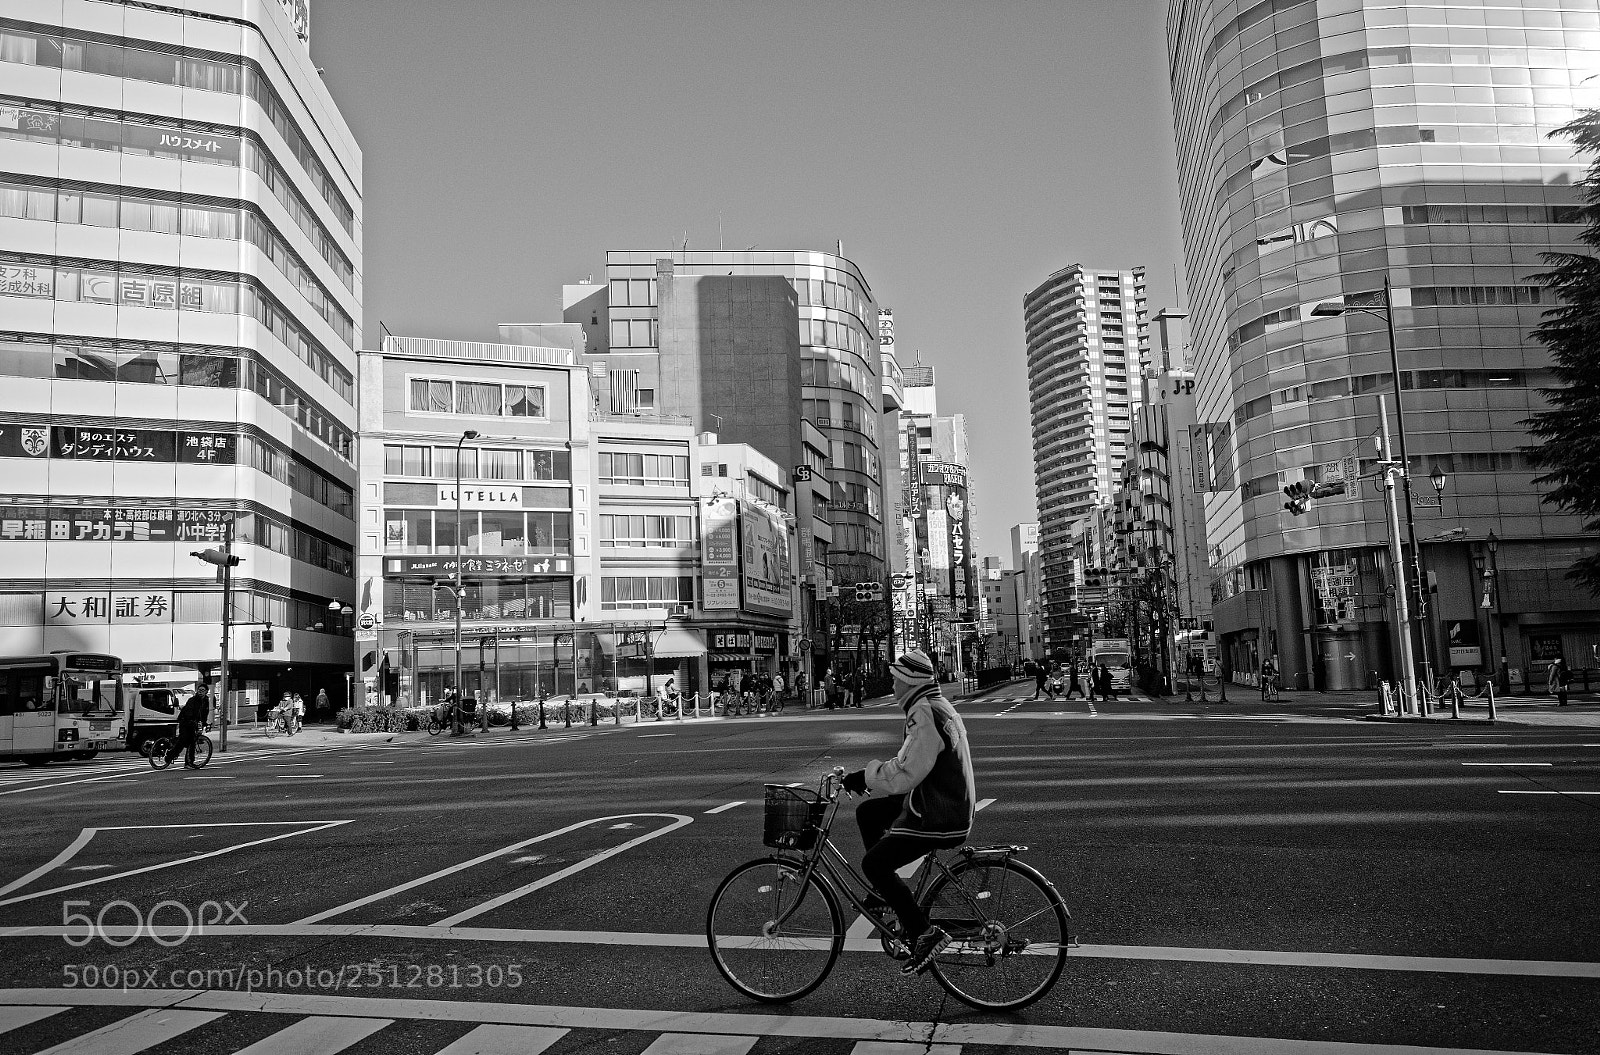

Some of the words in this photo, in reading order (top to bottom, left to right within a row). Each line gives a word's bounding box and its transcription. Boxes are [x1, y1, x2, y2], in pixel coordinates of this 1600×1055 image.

[160, 134, 222, 152] ハウスメイト
[123, 280, 204, 306] 吉原組
[80, 431, 137, 442] 男のエステ
[186, 435, 227, 449] 池袋店
[61, 443, 155, 457] ダンディハウス
[196, 449, 216, 460] 4F
[440, 490, 518, 503] LUTELLA
[2, 520, 166, 540] 早稲田アカデミー
[952, 522, 965, 564] パセラ
[51, 595, 168, 618] 大和証券
